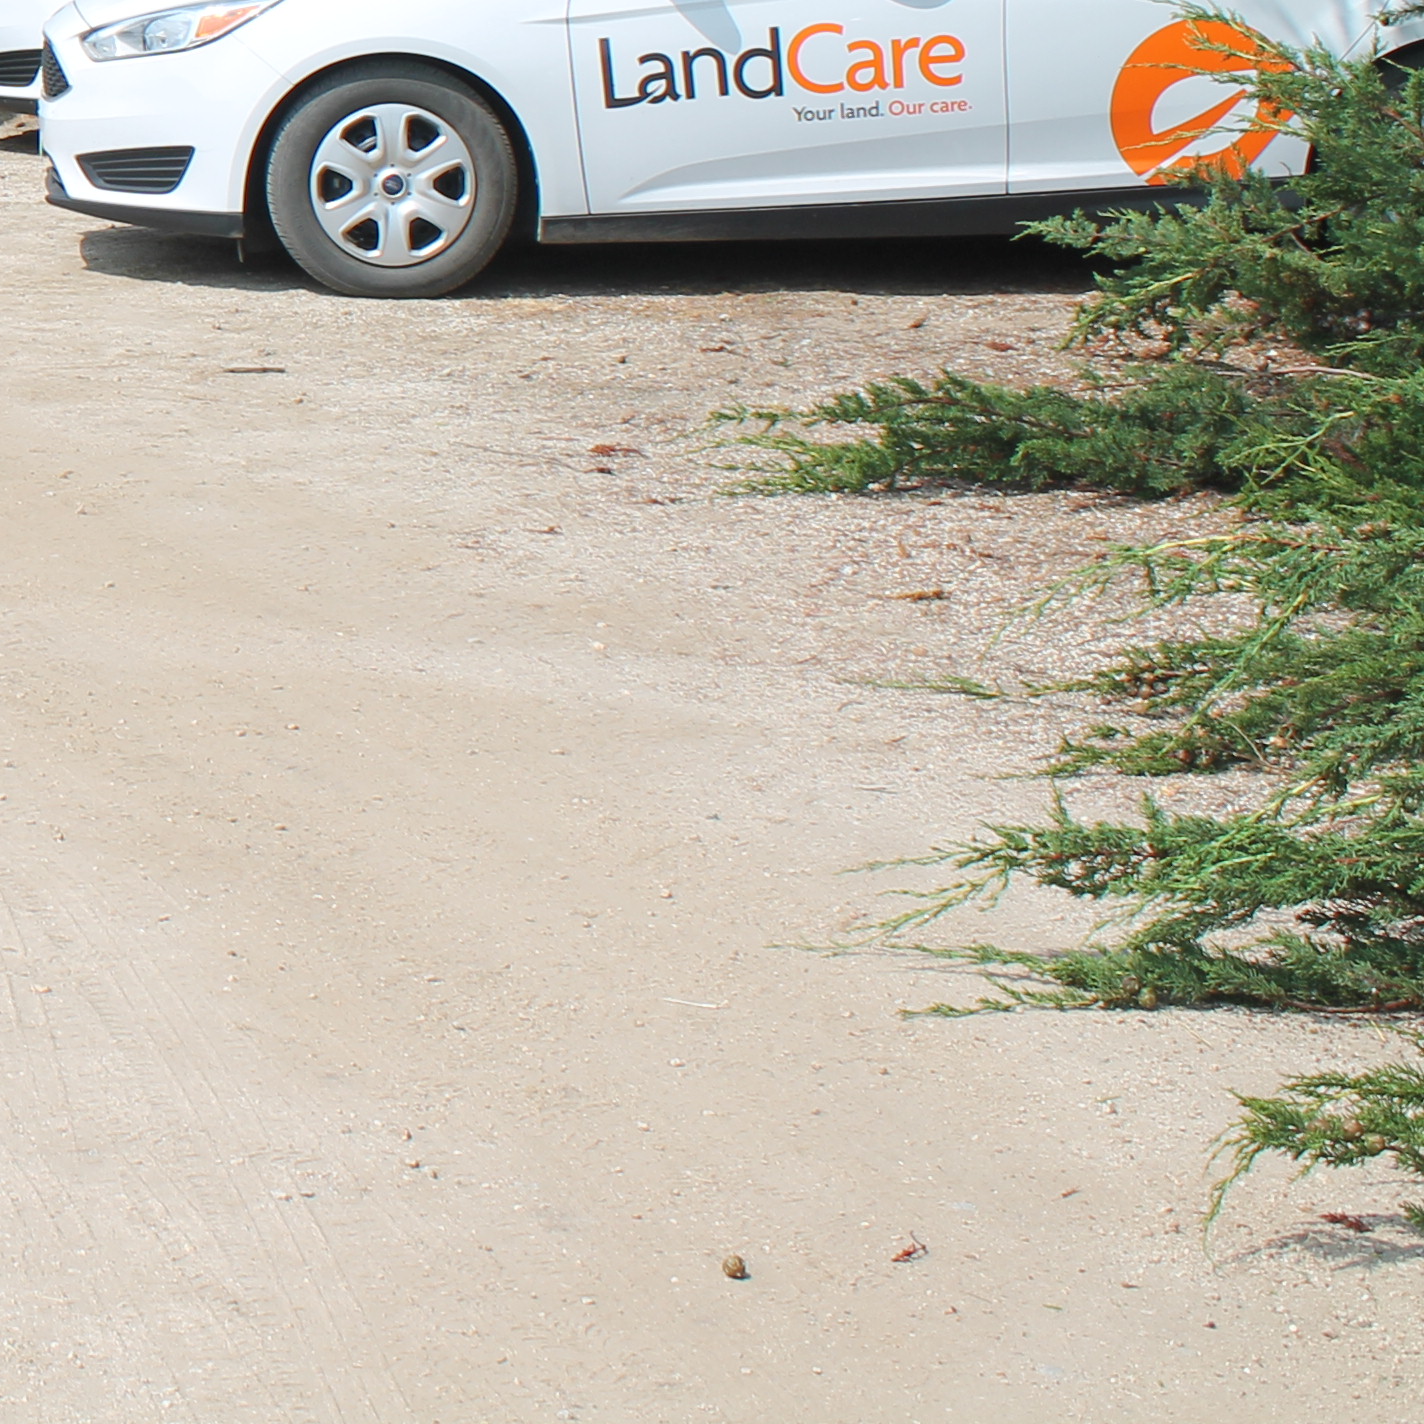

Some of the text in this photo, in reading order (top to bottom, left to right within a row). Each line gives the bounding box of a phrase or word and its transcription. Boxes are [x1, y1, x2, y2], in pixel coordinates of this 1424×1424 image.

[598, 22, 967, 110] LandCare
[791, 99, 973, 123] Your land. Our care.
